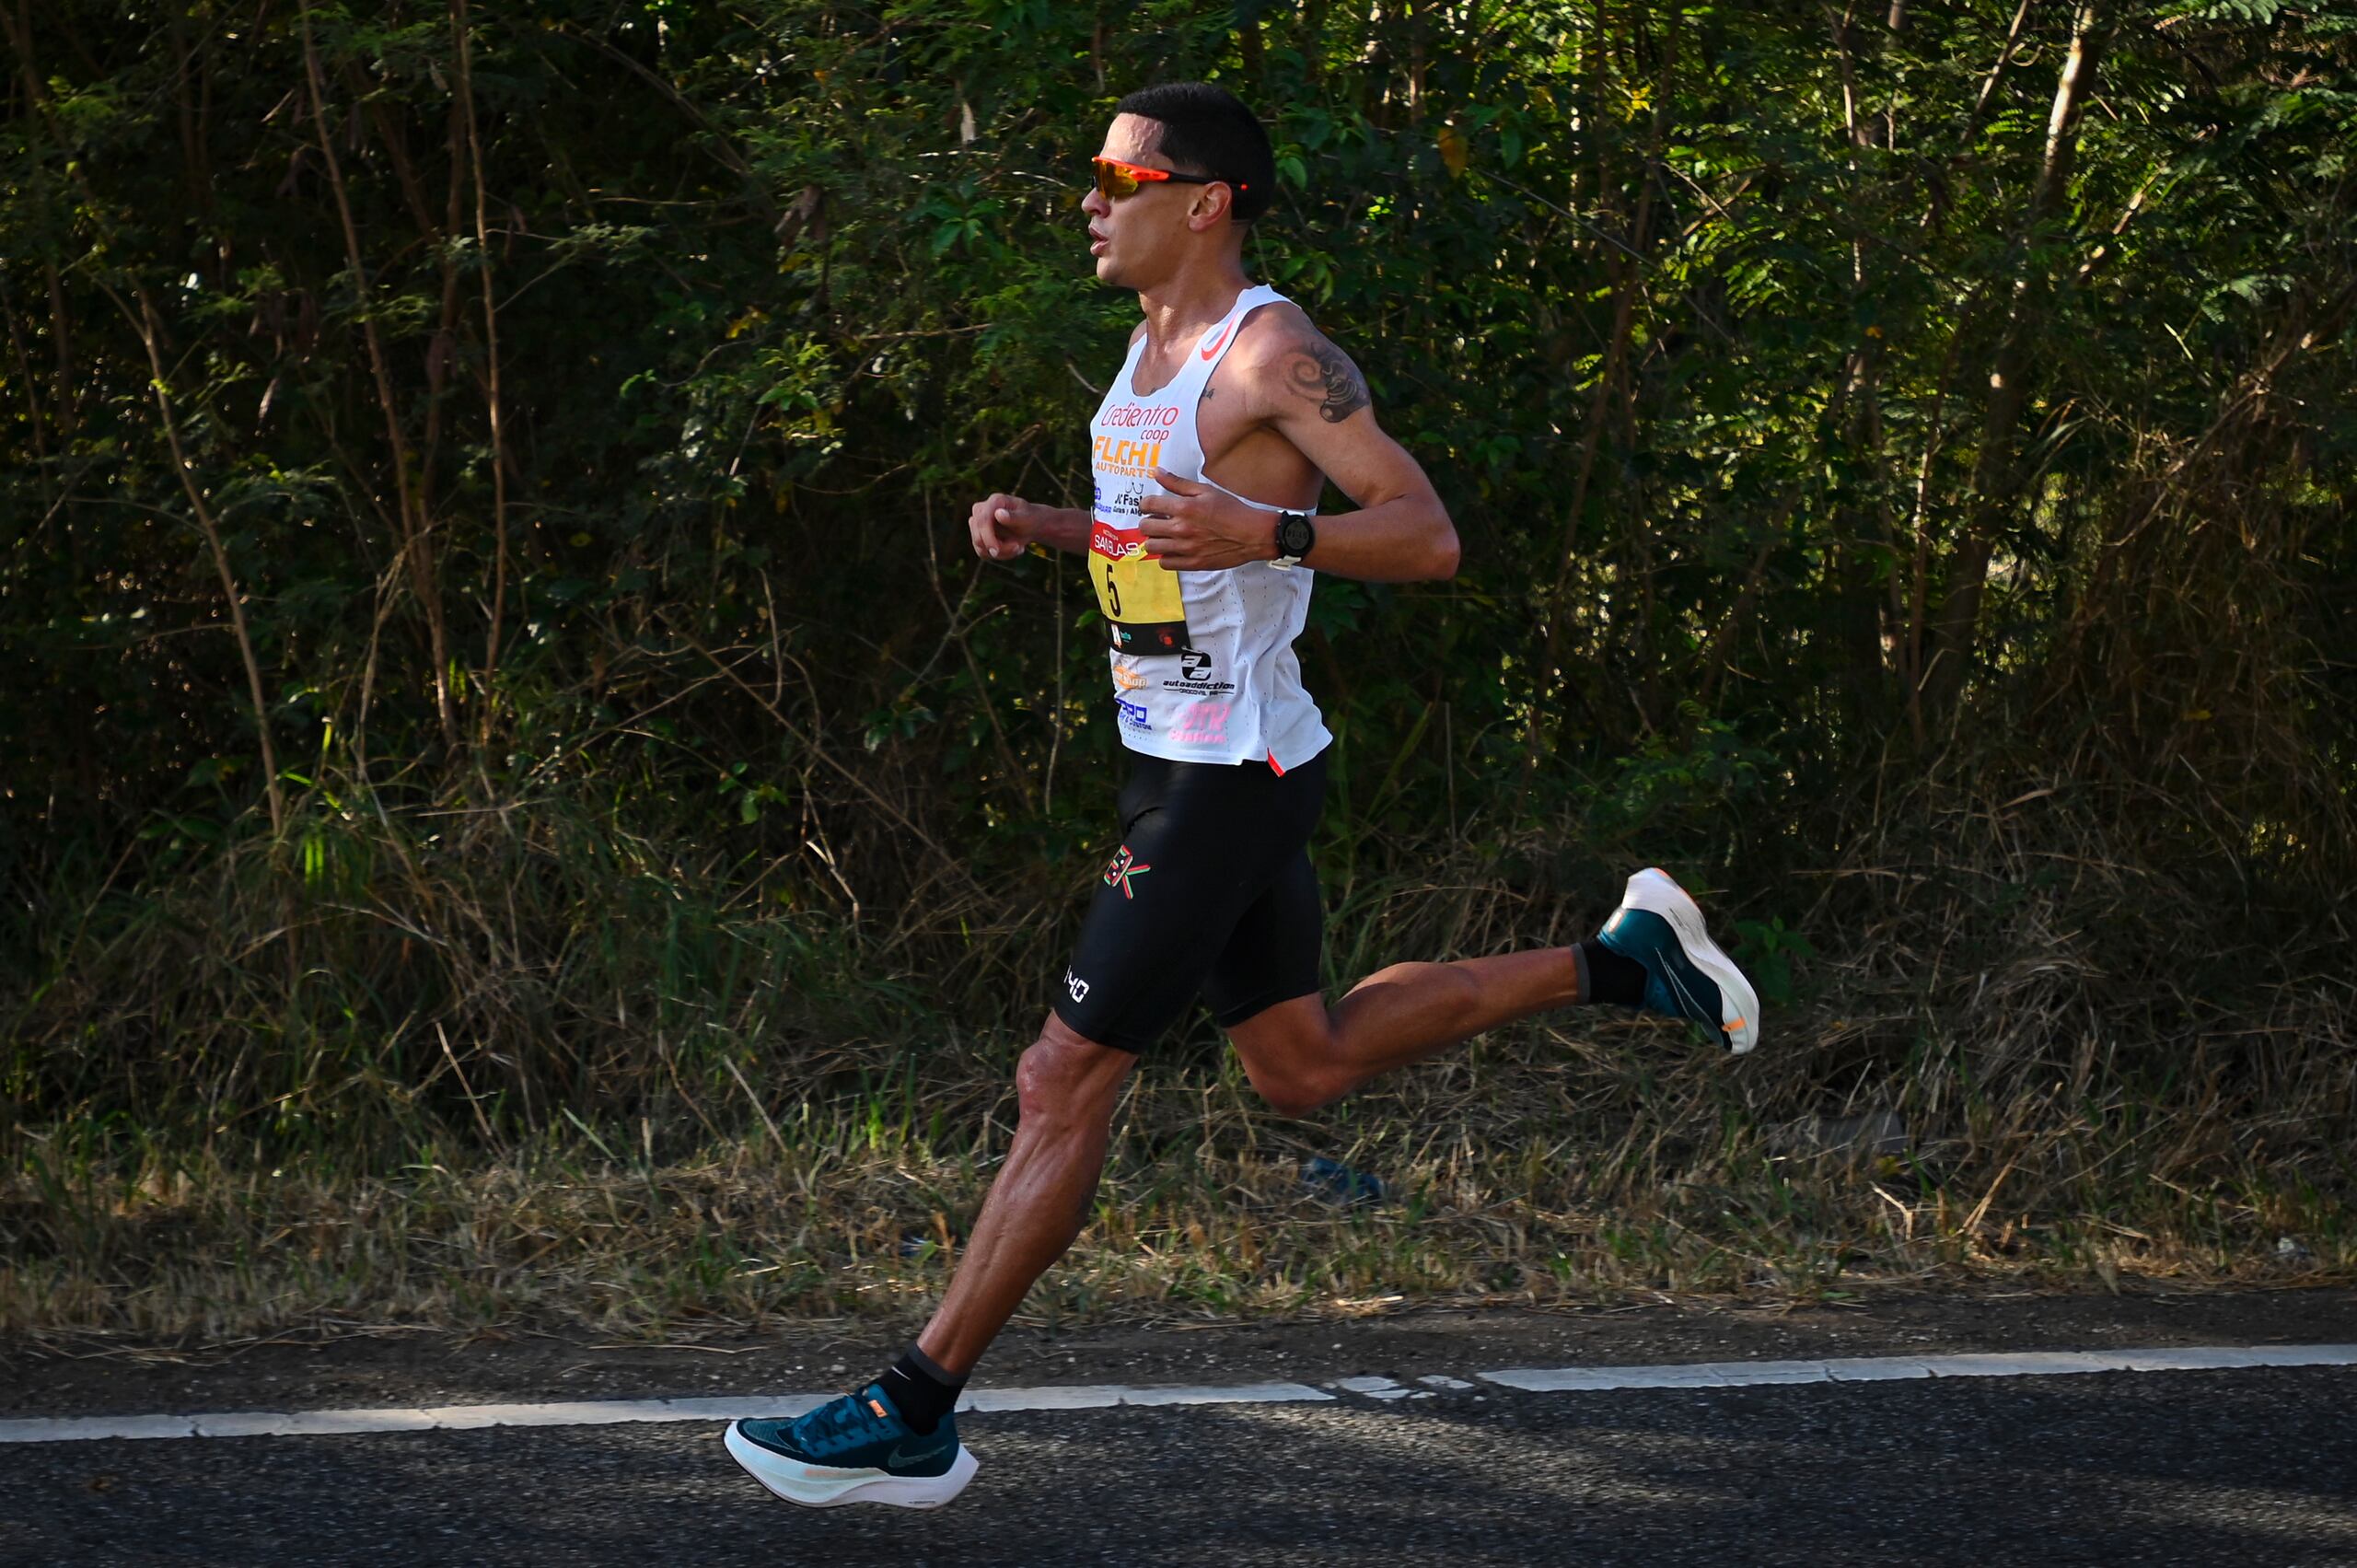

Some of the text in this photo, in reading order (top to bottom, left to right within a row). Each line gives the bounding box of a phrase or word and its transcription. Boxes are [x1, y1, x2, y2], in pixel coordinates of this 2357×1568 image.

[1141, 429, 1169, 444] coop
[1096, 461, 1155, 479] AUTOPARTS
[1107, 563, 1120, 617] 5
[1163, 680, 1235, 690] autoaddiction
